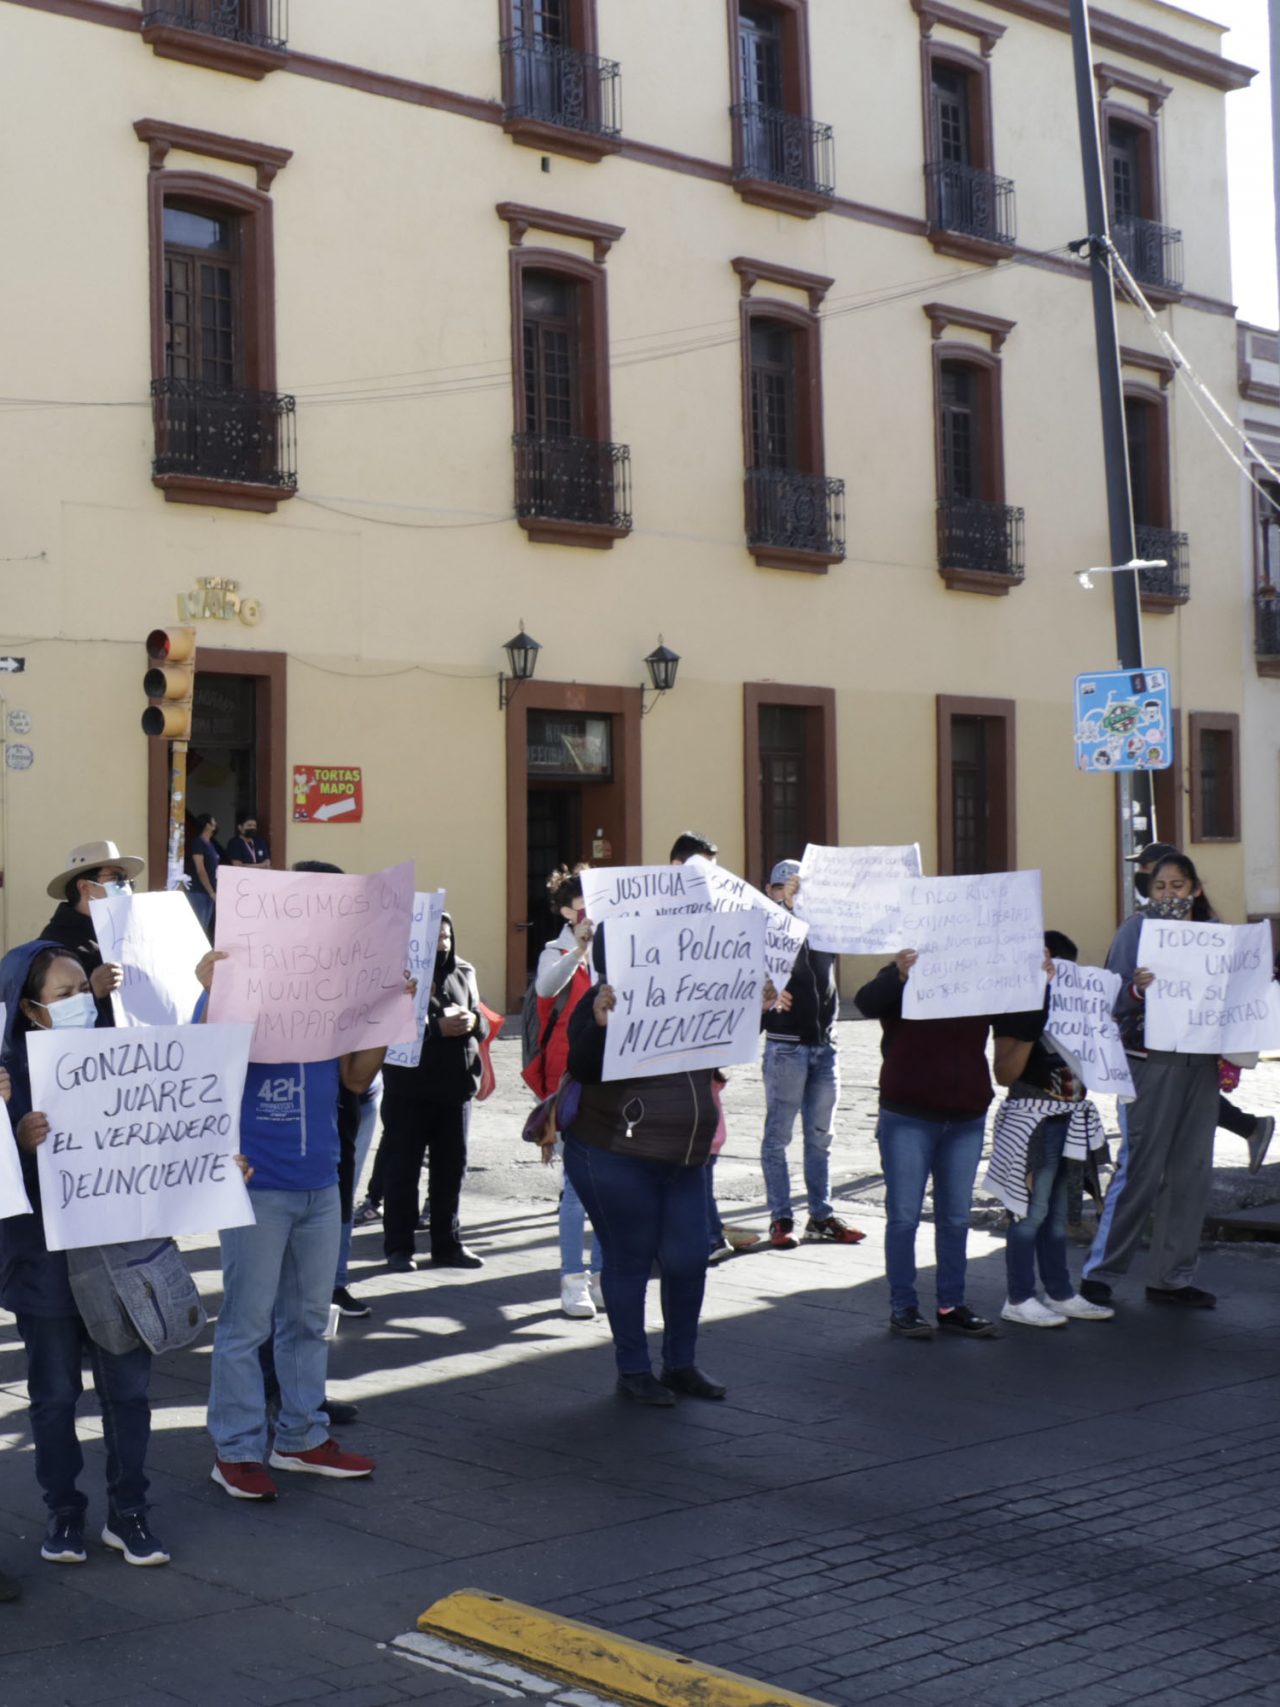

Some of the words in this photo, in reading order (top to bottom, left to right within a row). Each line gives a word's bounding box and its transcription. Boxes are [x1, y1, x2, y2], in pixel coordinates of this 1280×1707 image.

[314, 768, 361, 782] TORTAS
[320, 782, 355, 795] MAPO
[234, 878, 370, 921] EXIGIMOS
[609, 872, 686, 906] JUSTICIA
[236, 928, 377, 977] TRIBUNAL
[629, 934, 661, 968] La
[678, 925, 752, 963] Policía
[1156, 928, 1226, 949] TODOS
[246, 966, 399, 1004] MUNICIPAL
[621, 989, 635, 1016] y
[645, 976, 667, 1008] la
[1157, 978, 1193, 1000] POR
[1204, 984, 1228, 1001] SU
[253, 1002, 382, 1042] IMPARCIAL
[619, 1007, 746, 1057] MIENTEN
[1187, 999, 1269, 1028] LIBERTAD
[55, 1040, 184, 1091] GONZALO
[52, 1131, 83, 1155] EL
[94, 1112, 232, 1151] VERDADERO
[59, 1152, 230, 1210] DELINCUENTE
